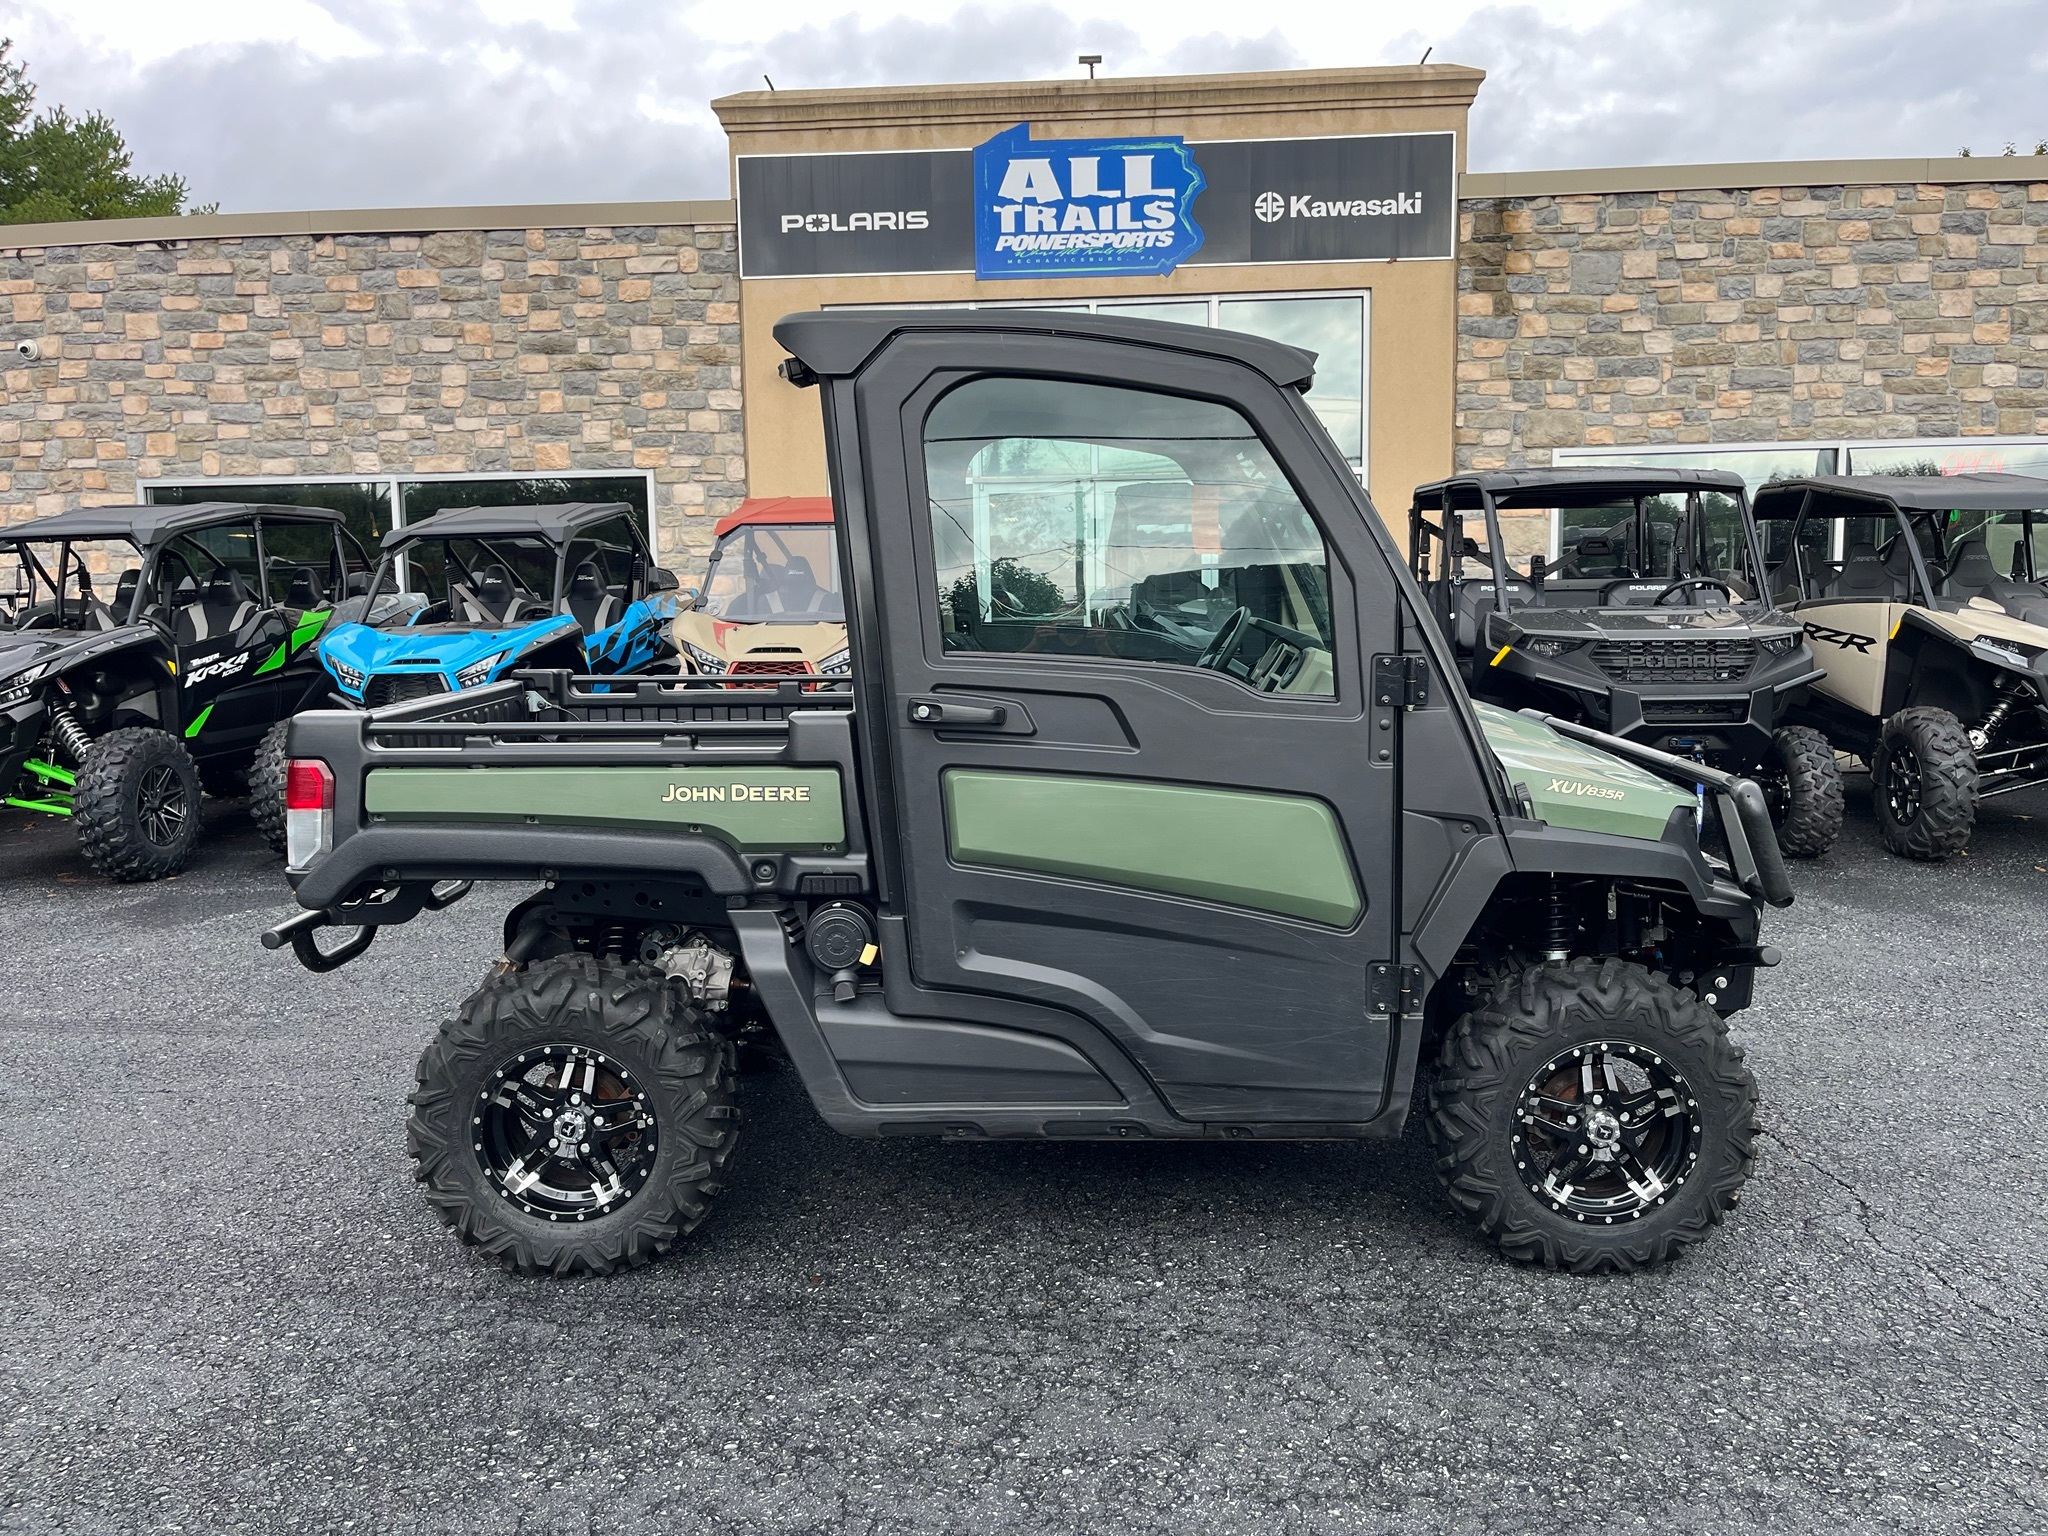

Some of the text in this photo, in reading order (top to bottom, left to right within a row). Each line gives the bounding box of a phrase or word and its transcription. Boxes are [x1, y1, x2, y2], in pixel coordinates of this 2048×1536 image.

[998, 155, 1175, 203] ALL
[1290, 192, 1422, 218] Kawasaki
[781, 211, 929, 233] POLARIS
[993, 201, 1175, 233] TRAILS
[995, 231, 1174, 252] POWERSPORTS
[1942, 452, 2006, 476] OPEN
[1803, 621, 1877, 654] RZR
[222, 665, 243, 677] 1000
[1628, 655, 1731, 667] POLARIS
[661, 783, 810, 802] JOHN DEERE
[1545, 778, 1625, 801] XUV835R
